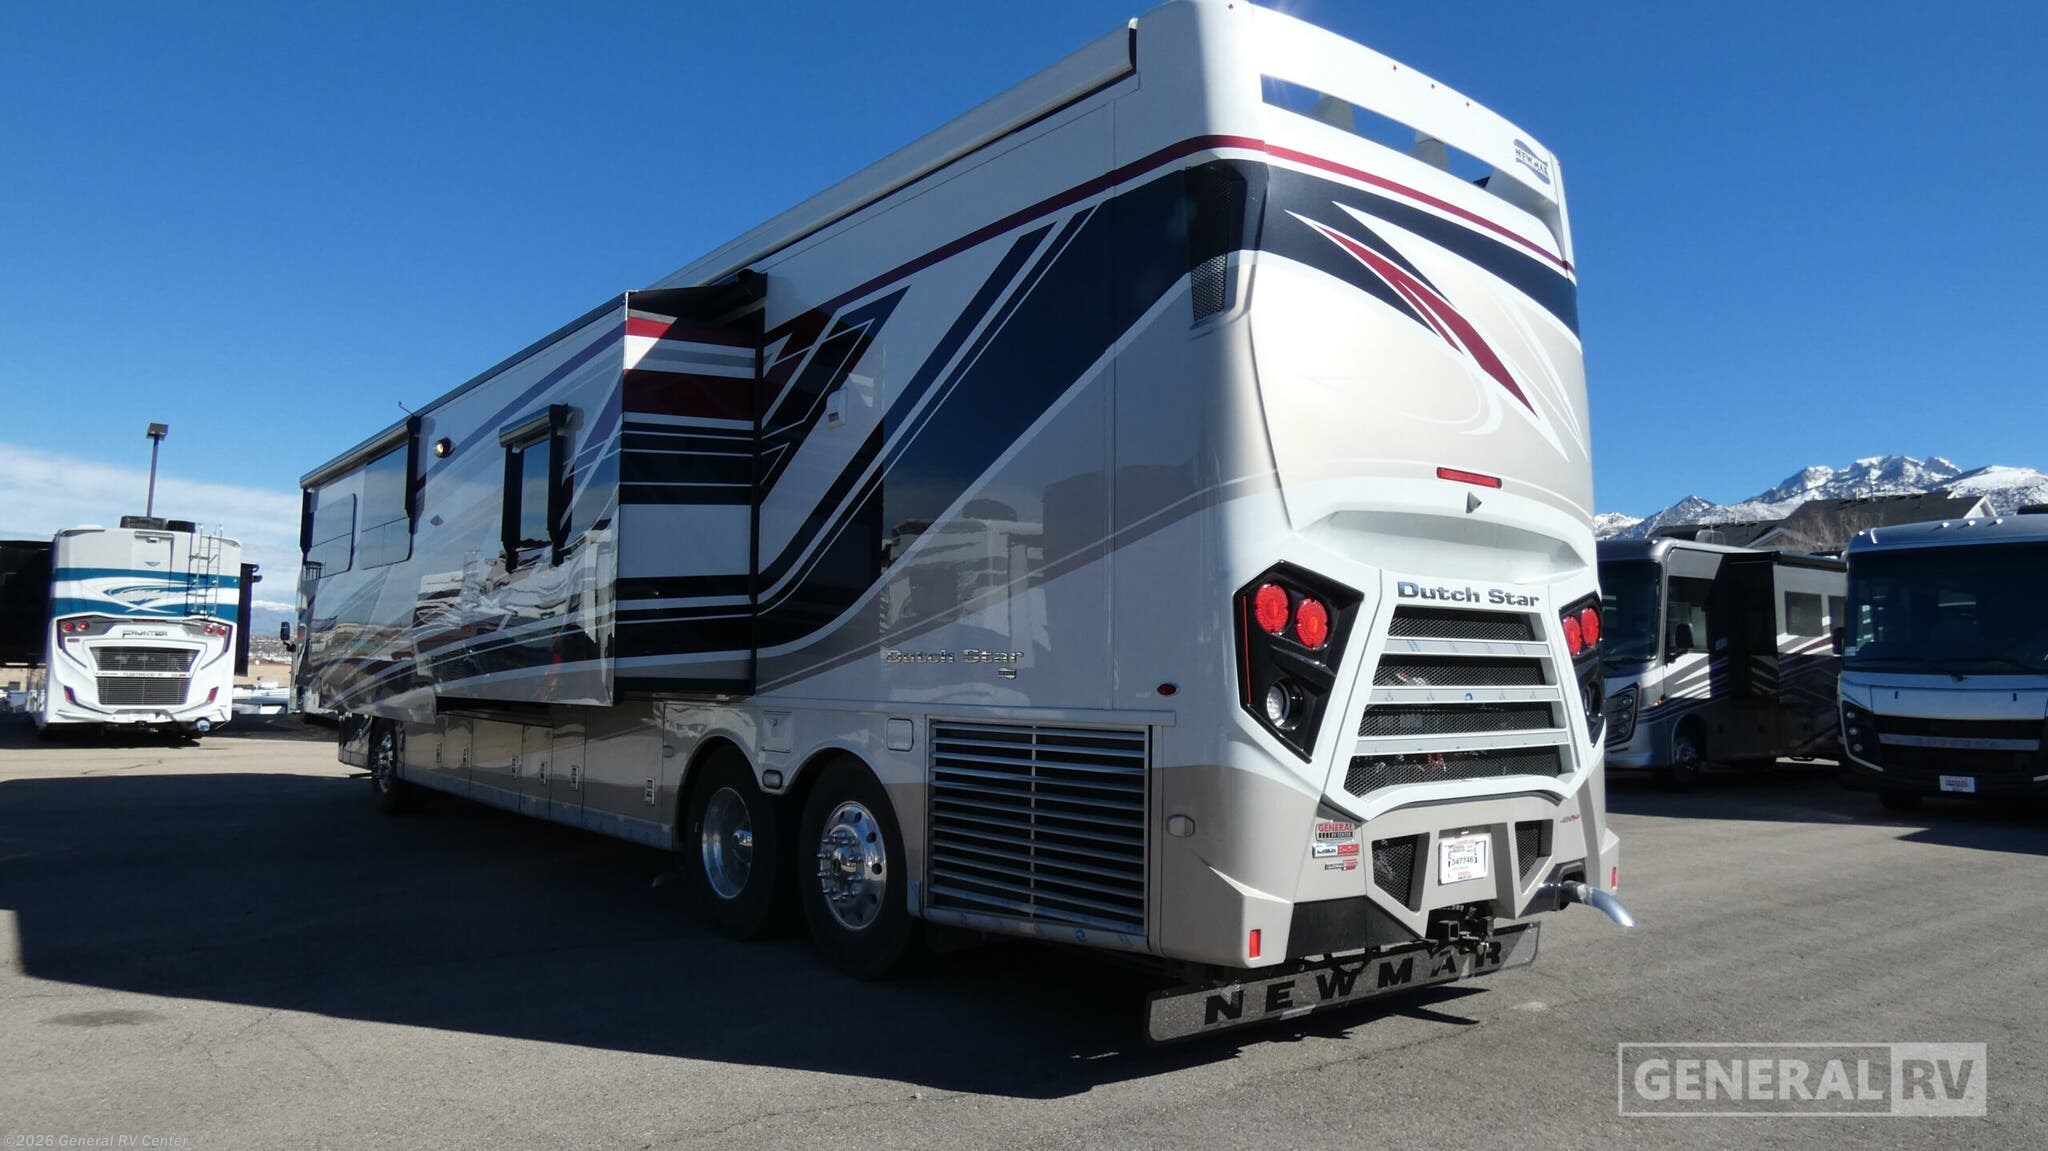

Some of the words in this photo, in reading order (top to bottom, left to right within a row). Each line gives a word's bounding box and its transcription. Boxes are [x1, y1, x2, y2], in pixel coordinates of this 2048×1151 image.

[1397, 581, 1480, 603] Dutch
[1488, 589, 1539, 607] Star
[886, 649, 955, 664] Dutch
[963, 649, 1024, 664] Star
[1318, 823, 1353, 832] GENERAL
[1204, 941, 1502, 1025] NEWMAR
